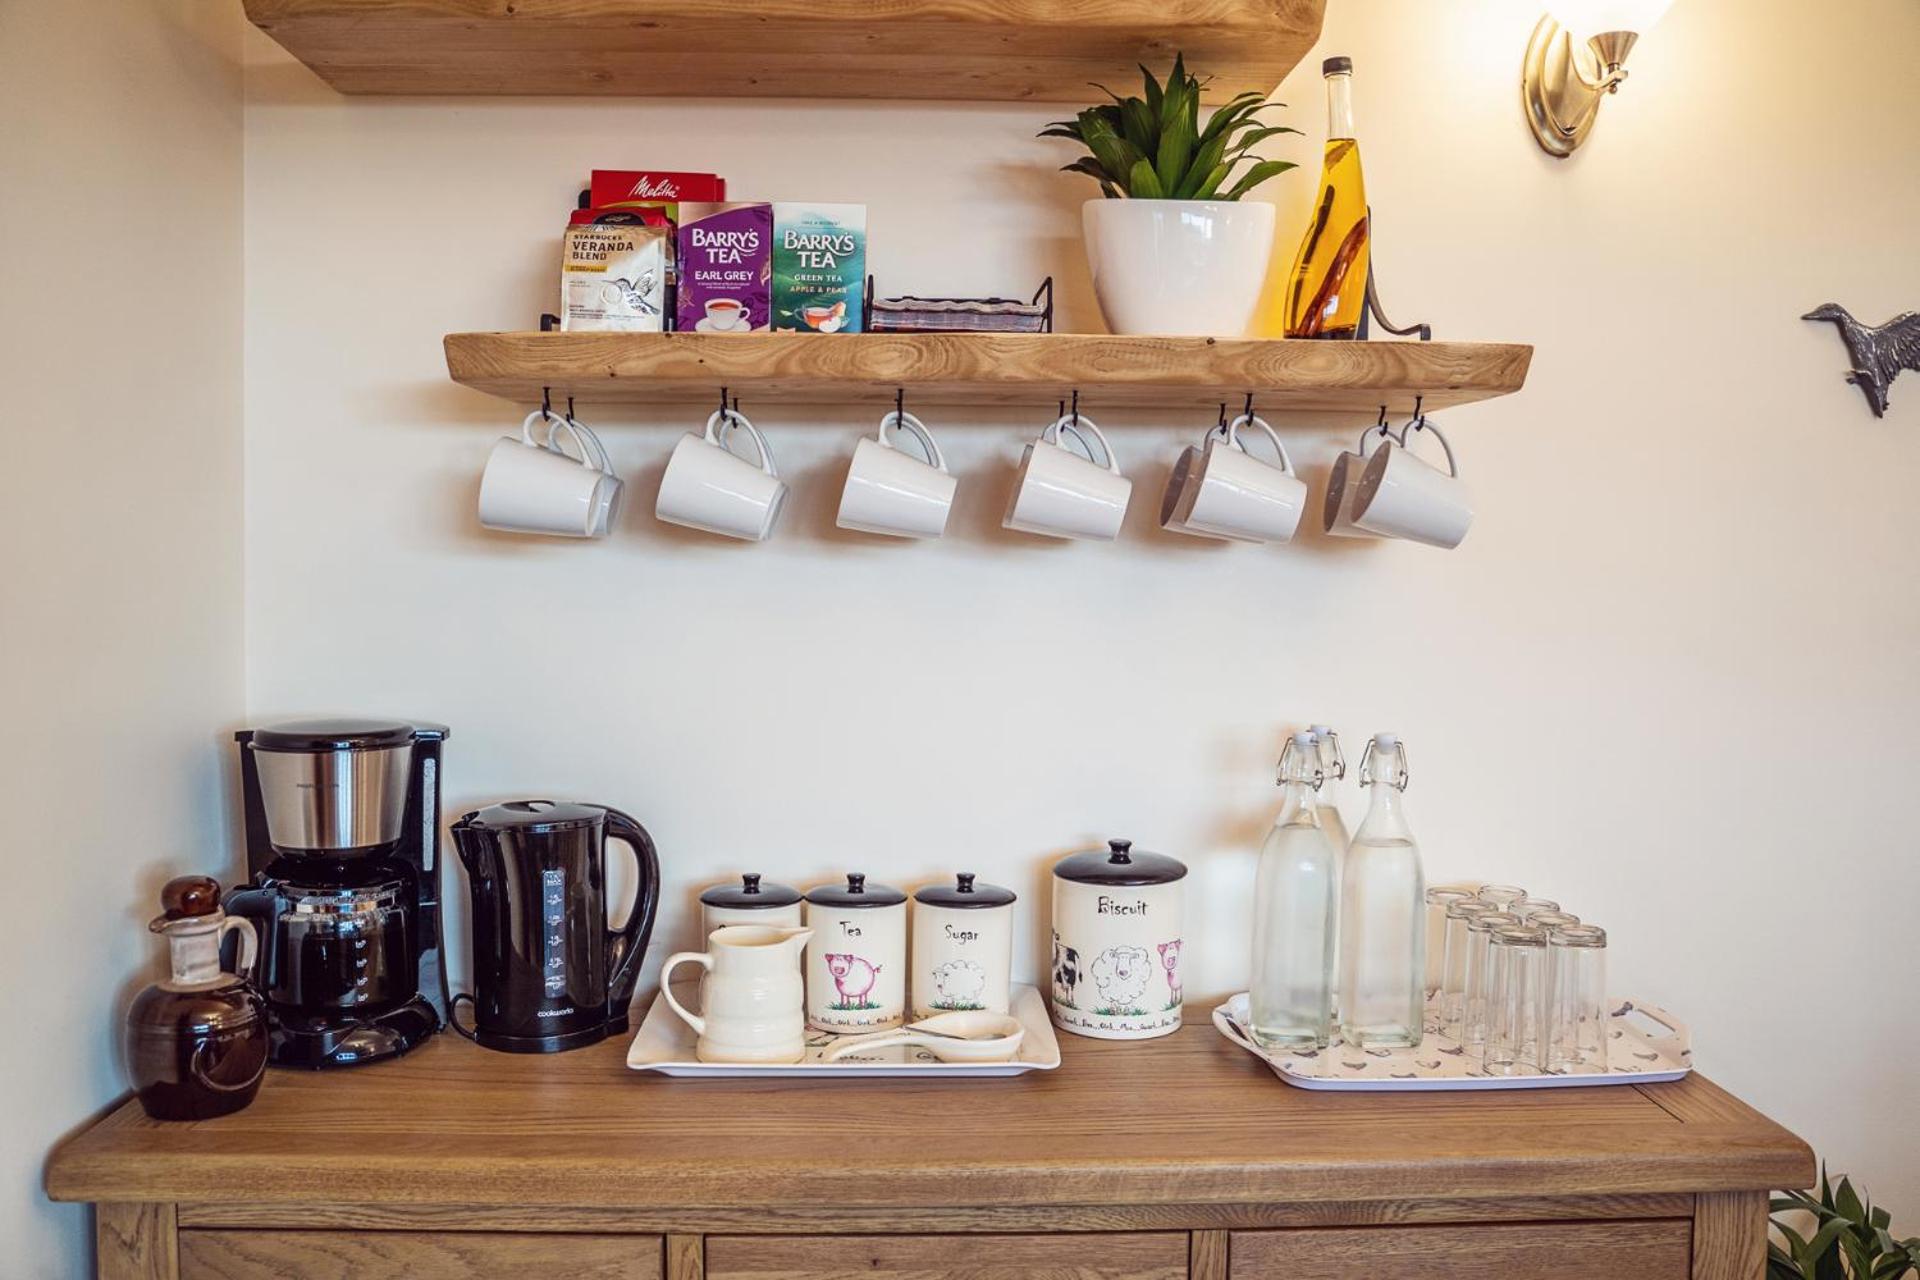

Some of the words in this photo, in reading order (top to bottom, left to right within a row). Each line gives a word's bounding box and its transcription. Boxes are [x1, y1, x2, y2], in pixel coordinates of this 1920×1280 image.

[628, 175, 678, 198] Melitta
[572, 241, 634, 252] VERANDA
[692, 228, 759, 252] BARRY'S
[784, 229, 855, 256] BARRY'S
[572, 251, 607, 261] BLEND
[705, 248, 742, 264] TEA
[797, 251, 836, 269] TEA
[695, 271, 722, 280] EARL
[724, 271, 754, 281] GREY
[794, 273, 823, 282] GREEN
[826, 274, 843, 282] TEA
[790, 286, 815, 294] APPLE
[1098, 896, 1148, 916] Biscuit
[840, 921, 862, 937] Tea
[945, 924, 979, 945] Sugar
